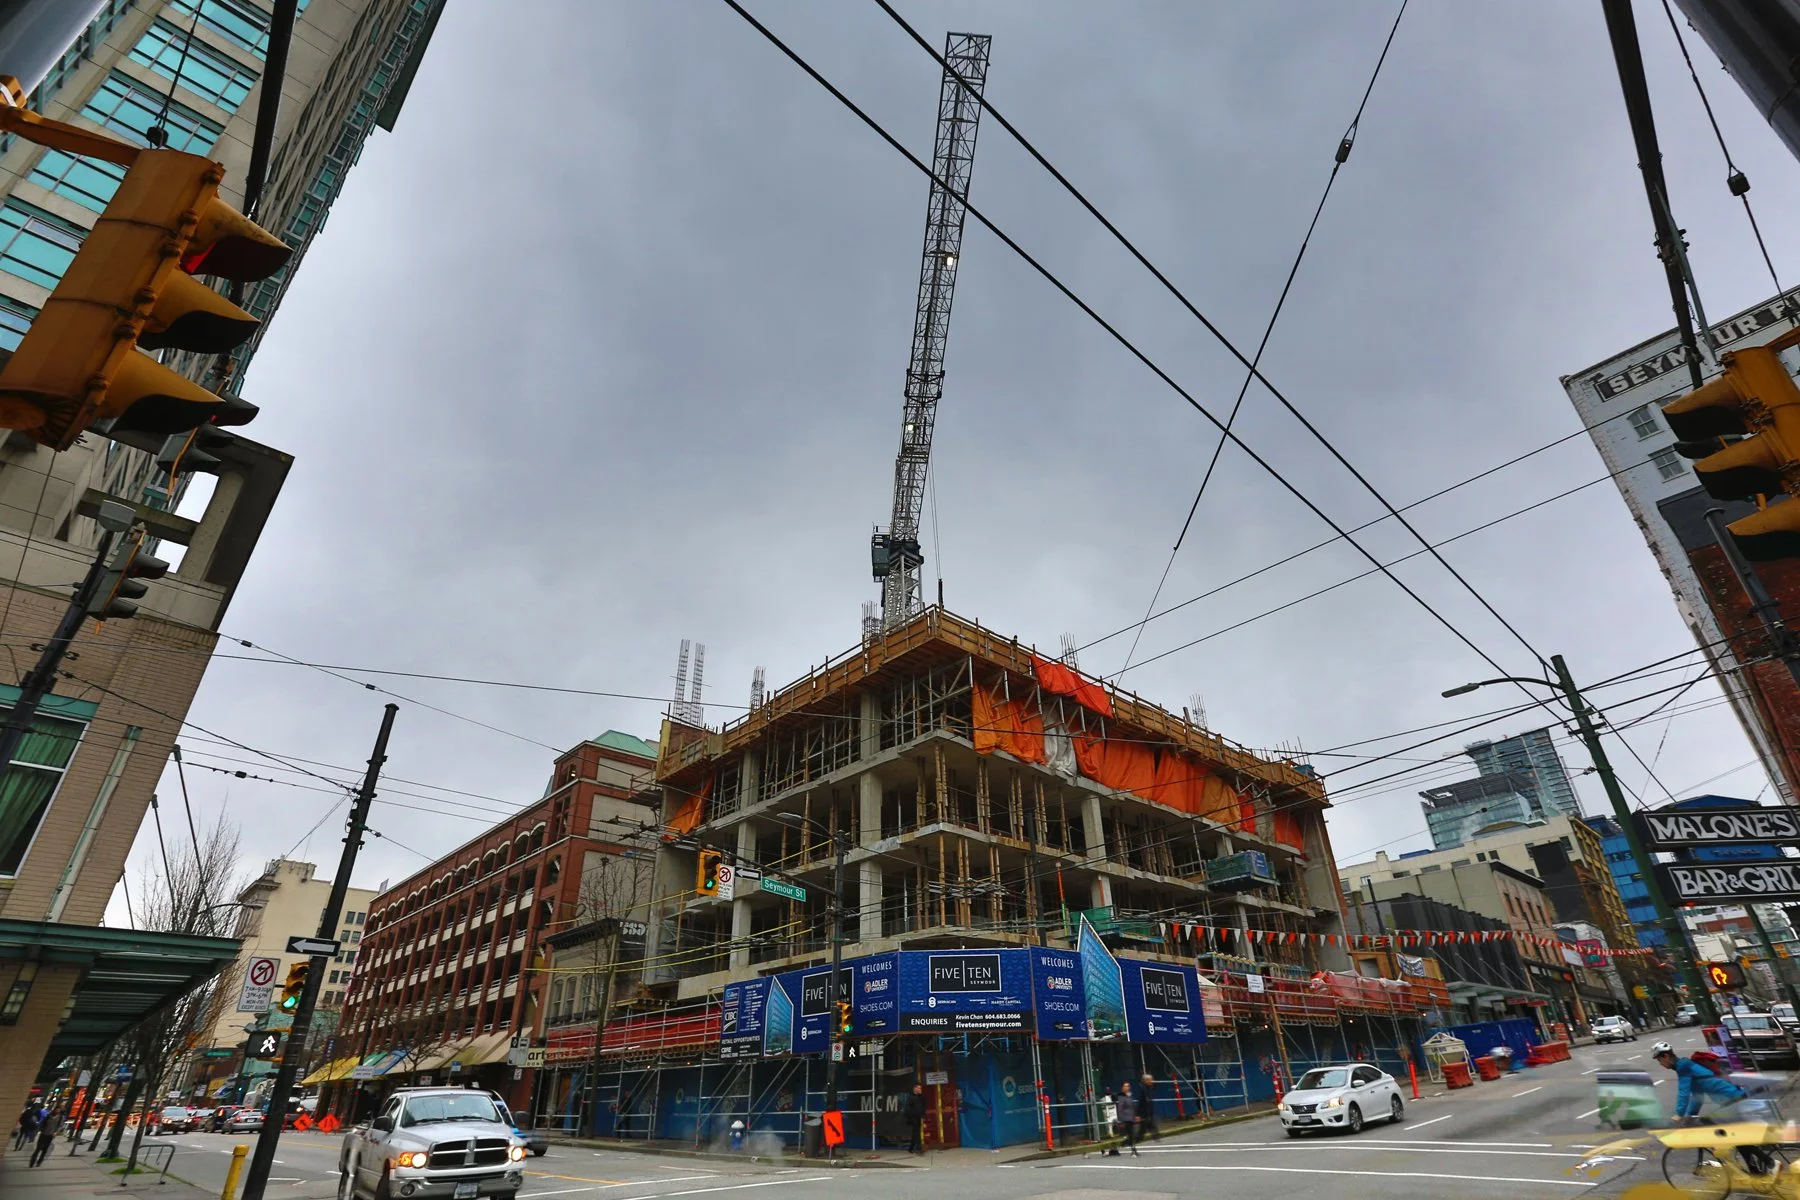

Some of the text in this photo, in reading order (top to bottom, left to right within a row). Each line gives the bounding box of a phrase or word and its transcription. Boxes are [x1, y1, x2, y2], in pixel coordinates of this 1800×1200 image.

[1609, 315, 1761, 394] SEYMUR
[1648, 813, 1798, 840] MALONE'S
[764, 880, 802, 898] Seymour St
[862, 961, 892, 974] WELCOMES
[1041, 956, 1074, 969] WELCOMES
[934, 967, 991, 979] FIVE TEN
[872, 979, 888, 987] ADLER
[1055, 977, 1072, 985] ADLER
[805, 986, 824, 1001] FIVE
[1145, 981, 1183, 997] FIVE TEN
[860, 1002, 893, 1012] SHOES.COM
[1044, 1001, 1080, 1012] SHOES.COM
[725, 1011, 736, 1020] CIBC
